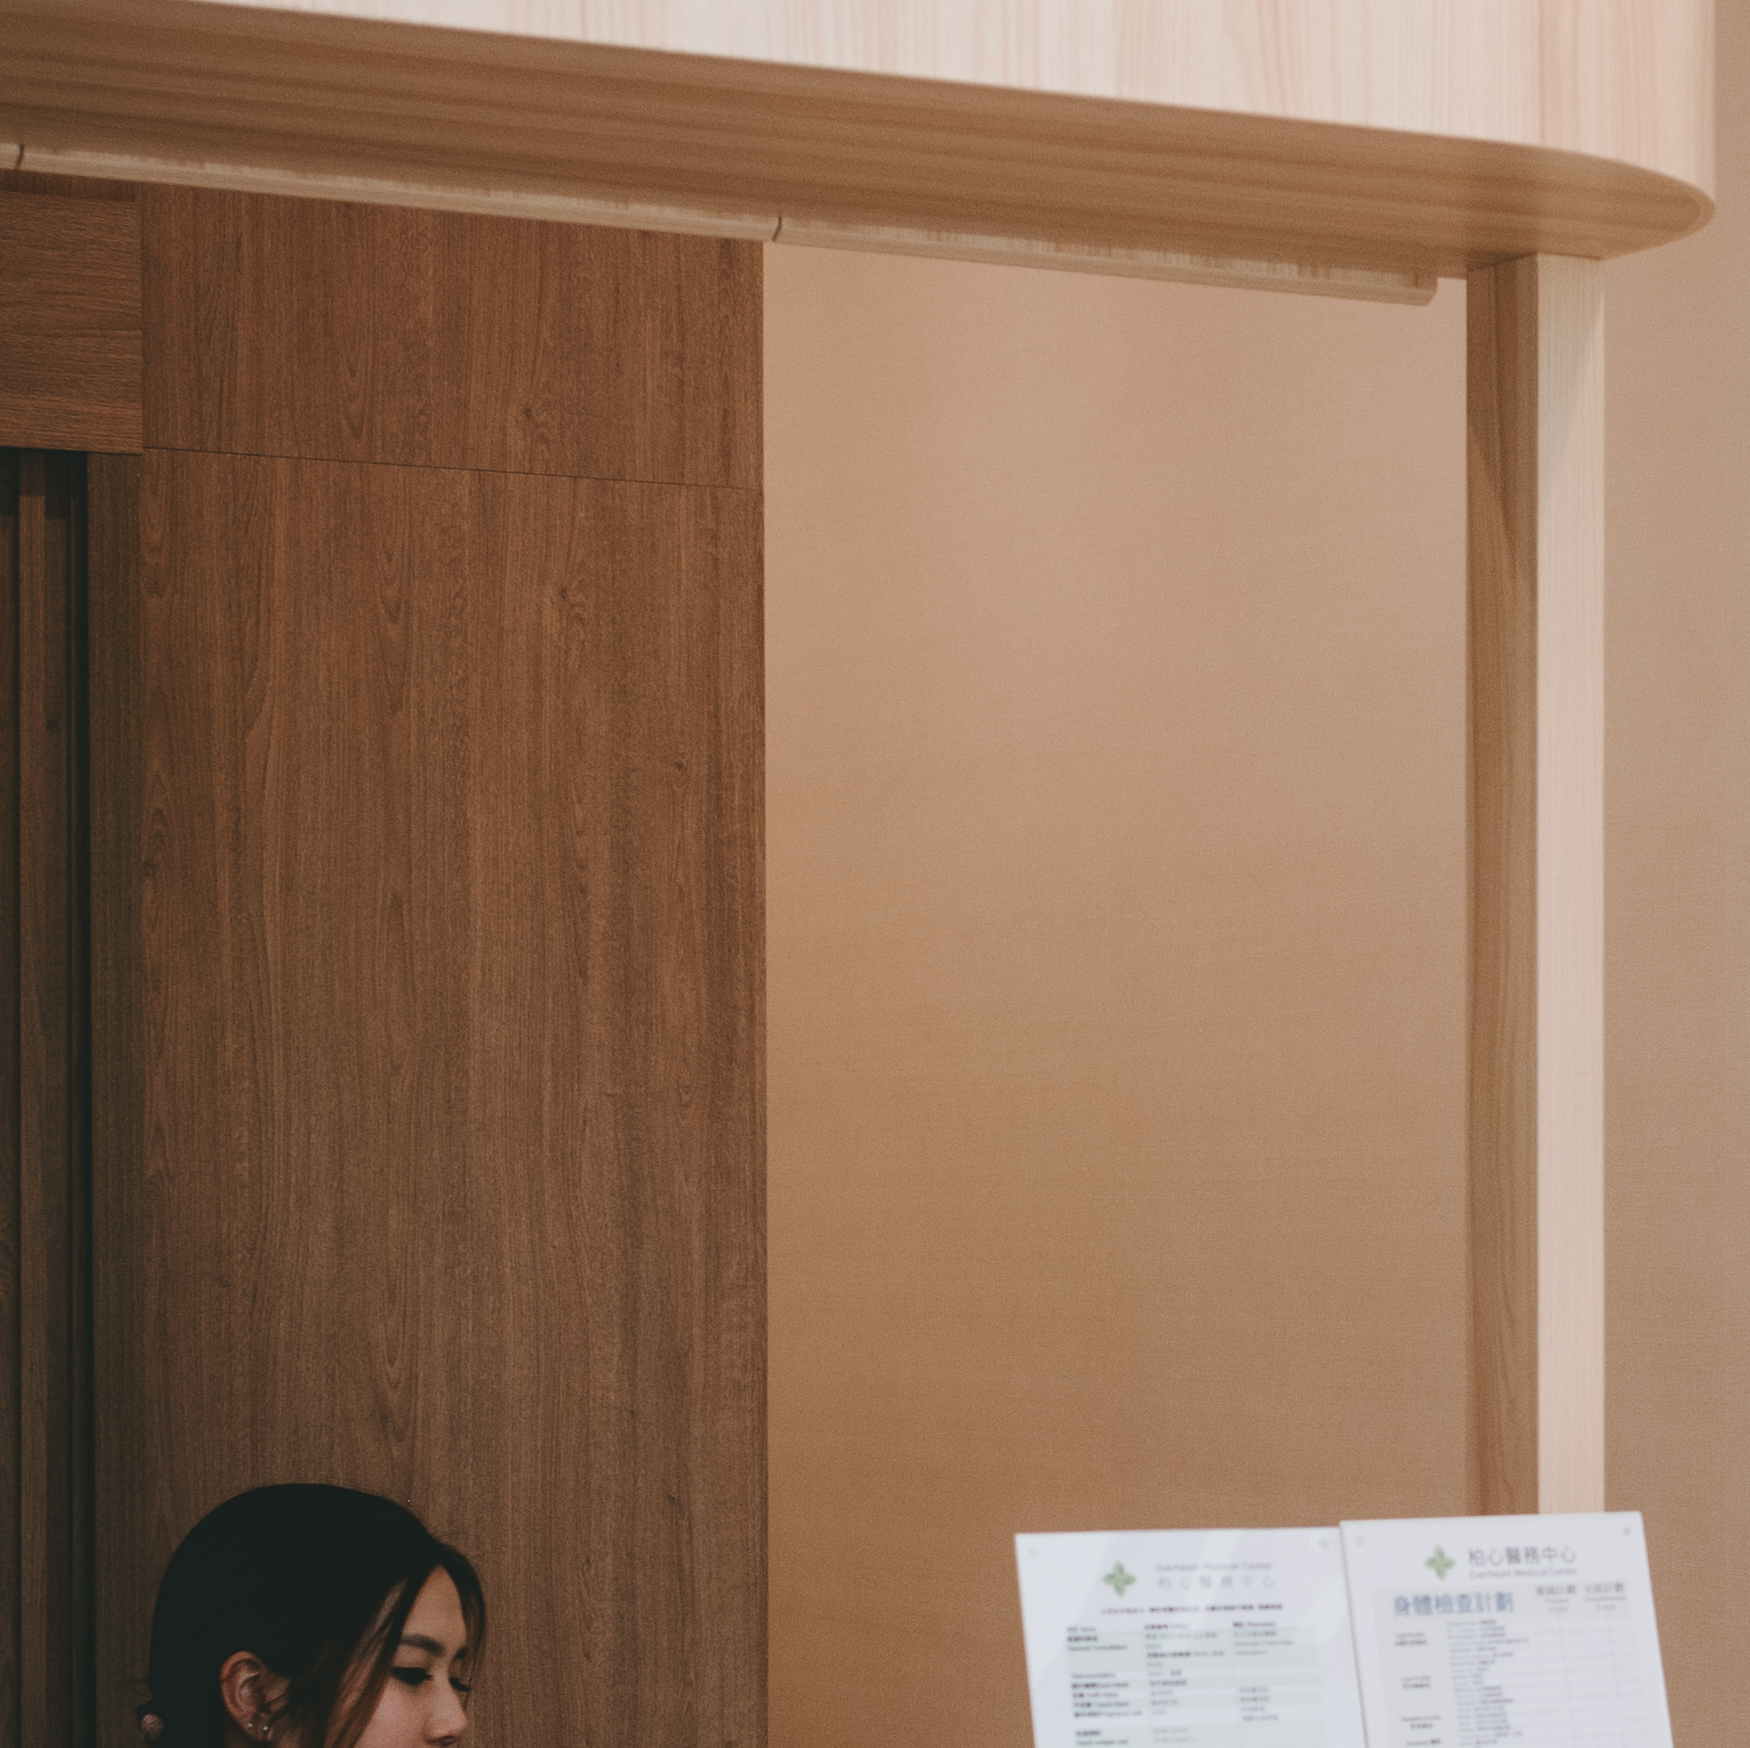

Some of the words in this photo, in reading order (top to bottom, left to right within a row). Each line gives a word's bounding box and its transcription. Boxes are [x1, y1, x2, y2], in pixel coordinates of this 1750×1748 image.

[1393, 1591, 1514, 1617] 身體檢查計劃
